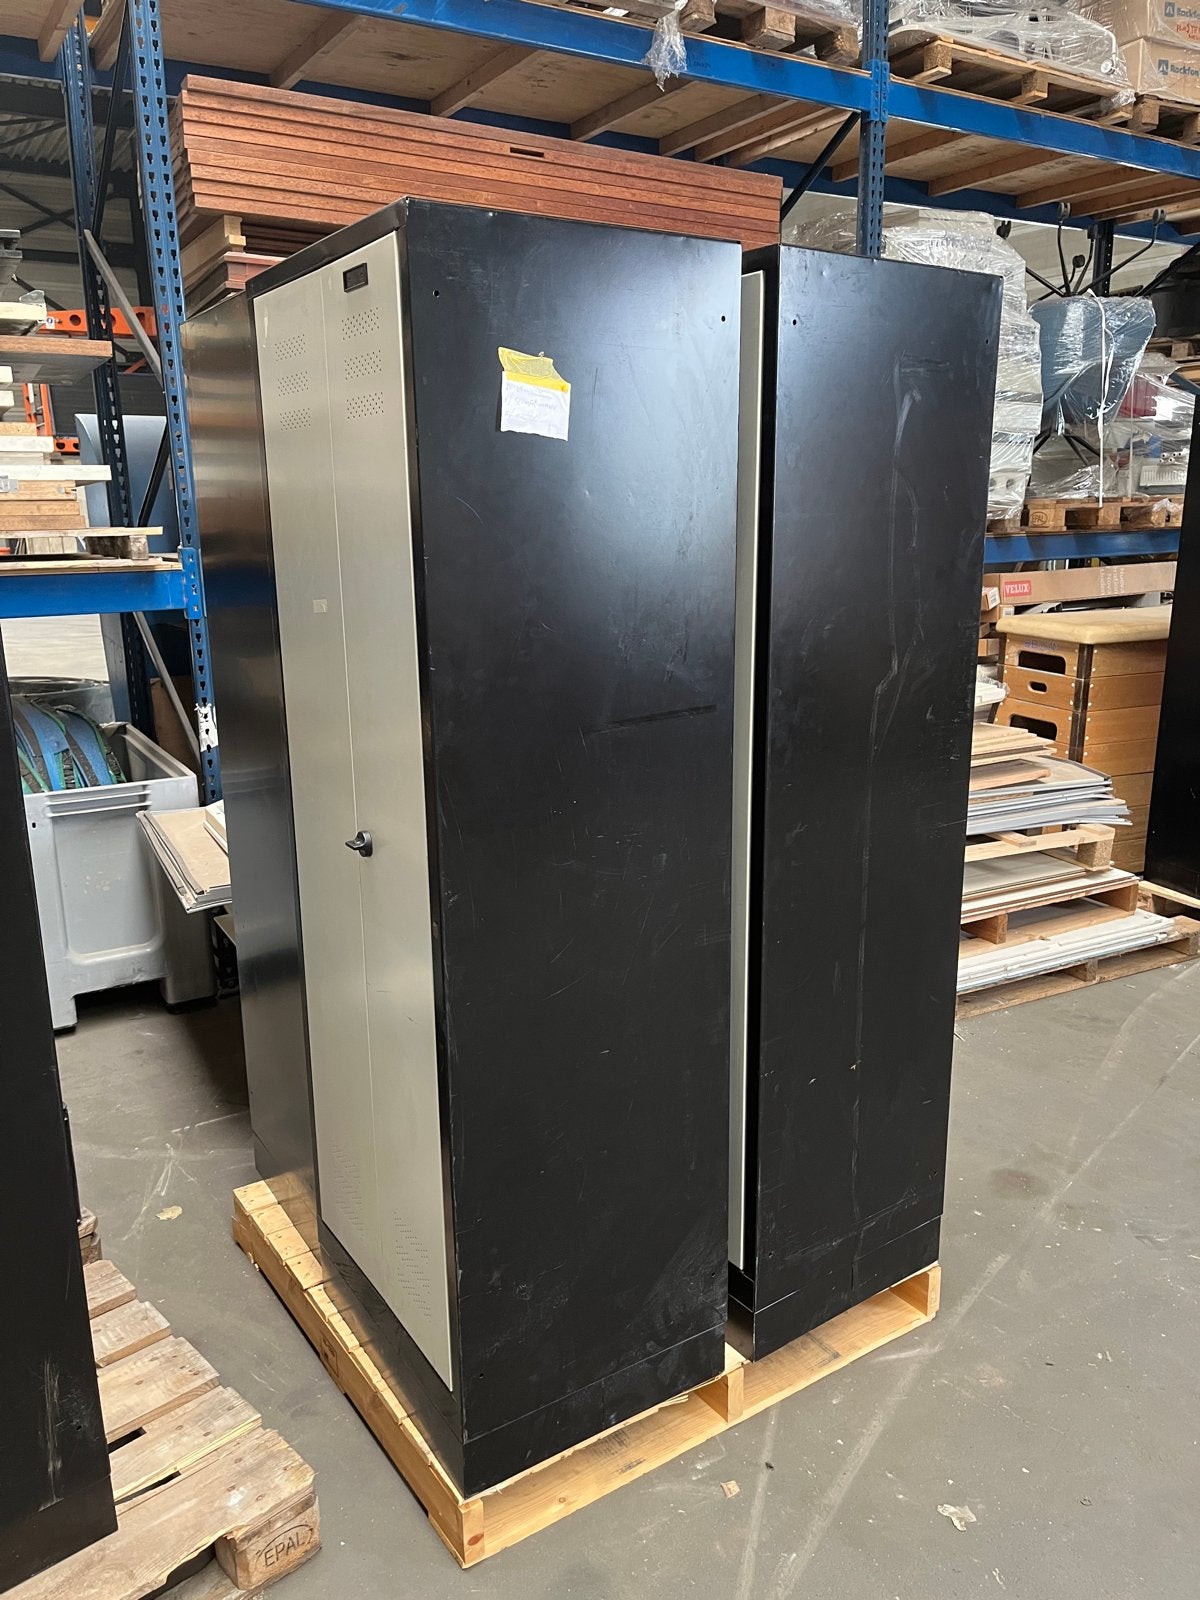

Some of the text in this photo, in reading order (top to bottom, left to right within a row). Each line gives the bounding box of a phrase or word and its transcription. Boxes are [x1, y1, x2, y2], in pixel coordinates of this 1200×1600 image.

[1170, 64, 1199, 77] Rockfon
[1005, 583, 1030, 594] VELUX
[264, 1531, 306, 1568] EPAL
